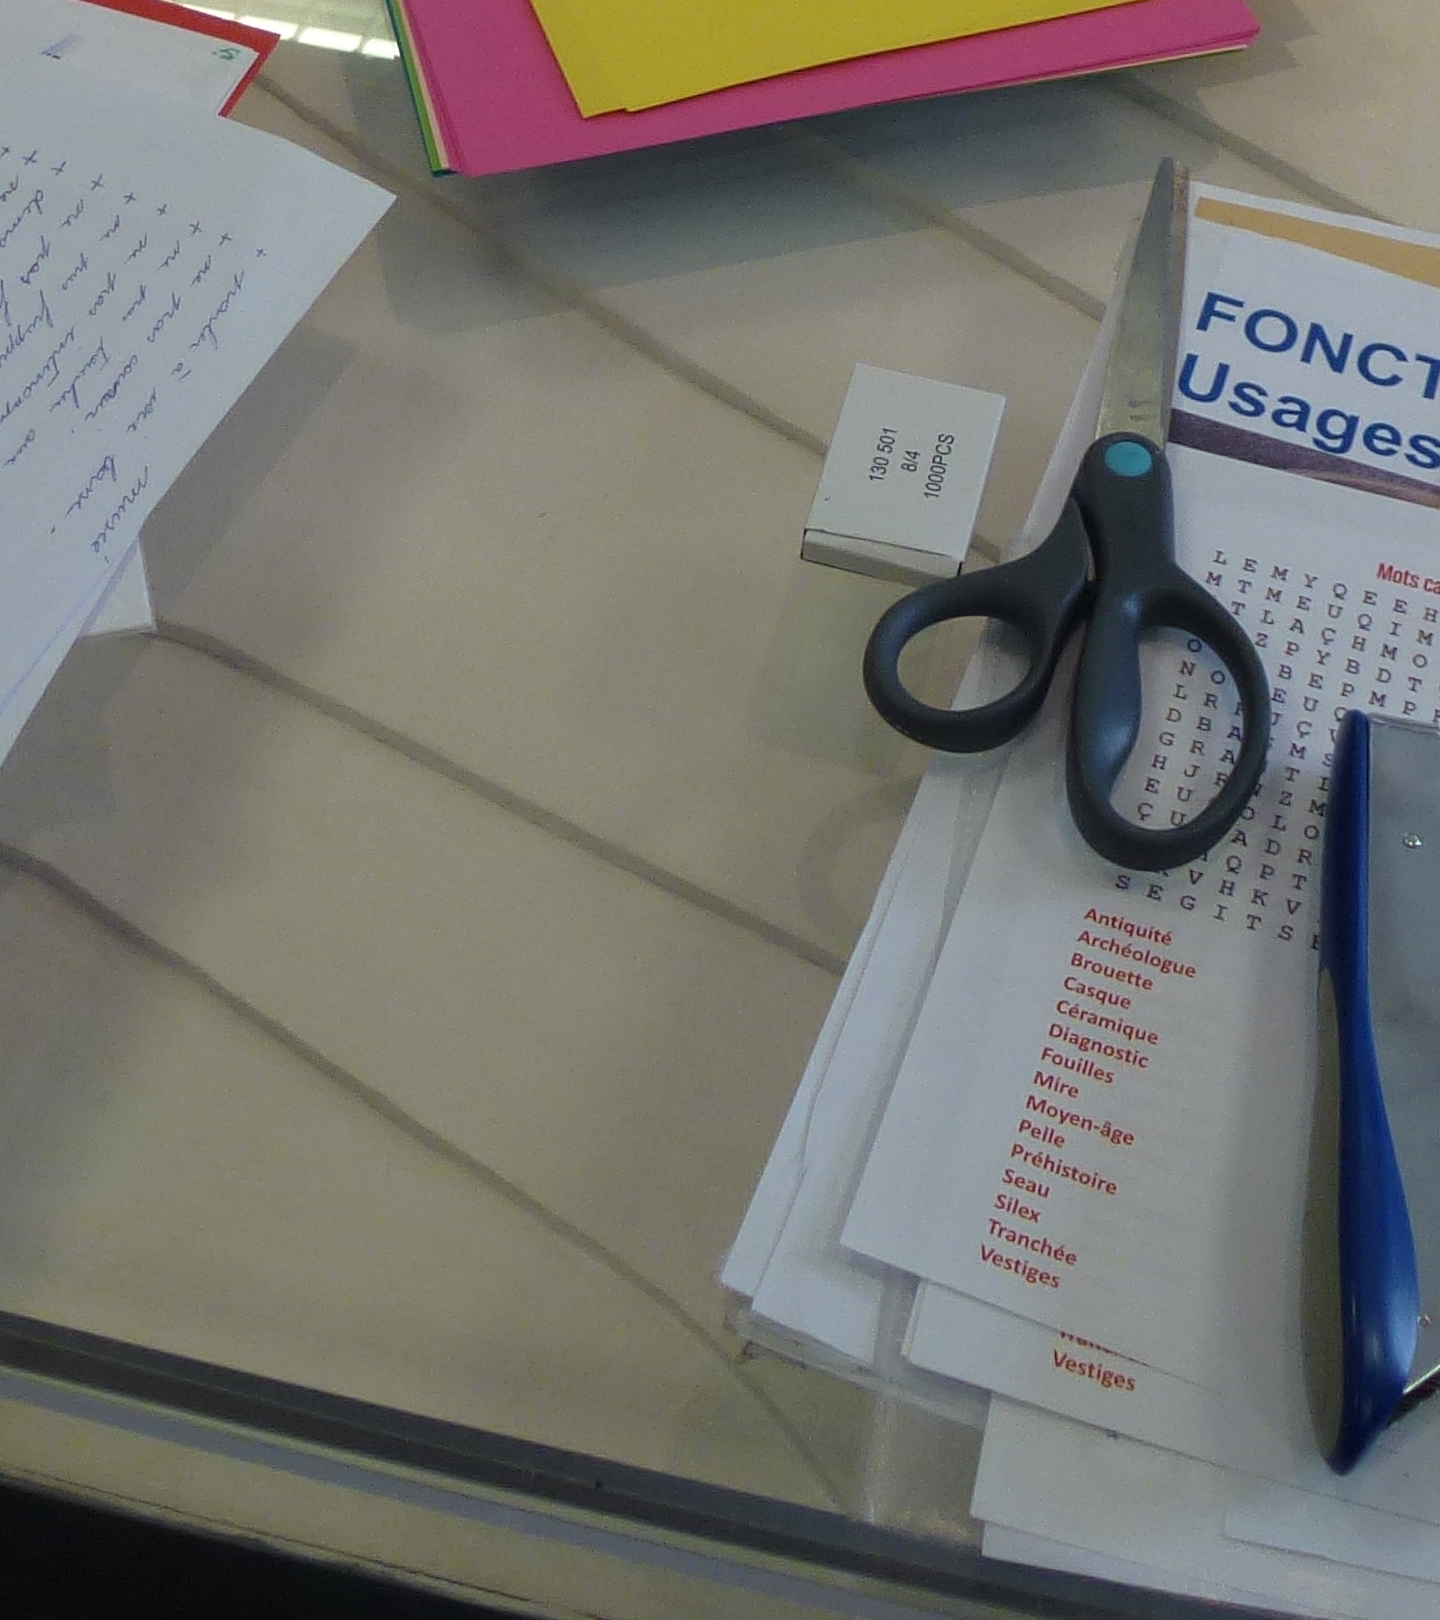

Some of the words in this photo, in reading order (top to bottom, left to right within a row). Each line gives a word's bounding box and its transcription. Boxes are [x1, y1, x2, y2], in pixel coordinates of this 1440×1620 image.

[878, 425, 900, 454] 501
[868, 452, 890, 484] 130
[900, 448, 922, 474] 8/4
[922, 432, 957, 500] 1000PCS
[1376, 562, 1420, 592] Mots
[1084, 907, 1173, 947] Antiquité
[1071, 952, 1154, 991] Brouette
[1076, 930, 1198, 979] Archéologue
[1064, 977, 1132, 1010] Casque
[1056, 1000, 1159, 1045] Céramique
[1048, 1024, 1150, 1068] Diagnostic
[1033, 1071, 1079, 1099] Mire
[1040, 1047, 1115, 1085] Fouilles
[1018, 1119, 1065, 1149] Pelle
[1025, 1095, 1135, 1146] Moyen-âge
[1001, 1168, 1051, 1199] Seau
[1010, 1144, 1117, 1196] Préhistoire
[994, 1194, 1042, 1223] Silex
[988, 1218, 1077, 1266] Tranchée
[980, 1244, 1060, 1288] Vestiges
[1052, 1348, 1136, 1392] Vestiges
